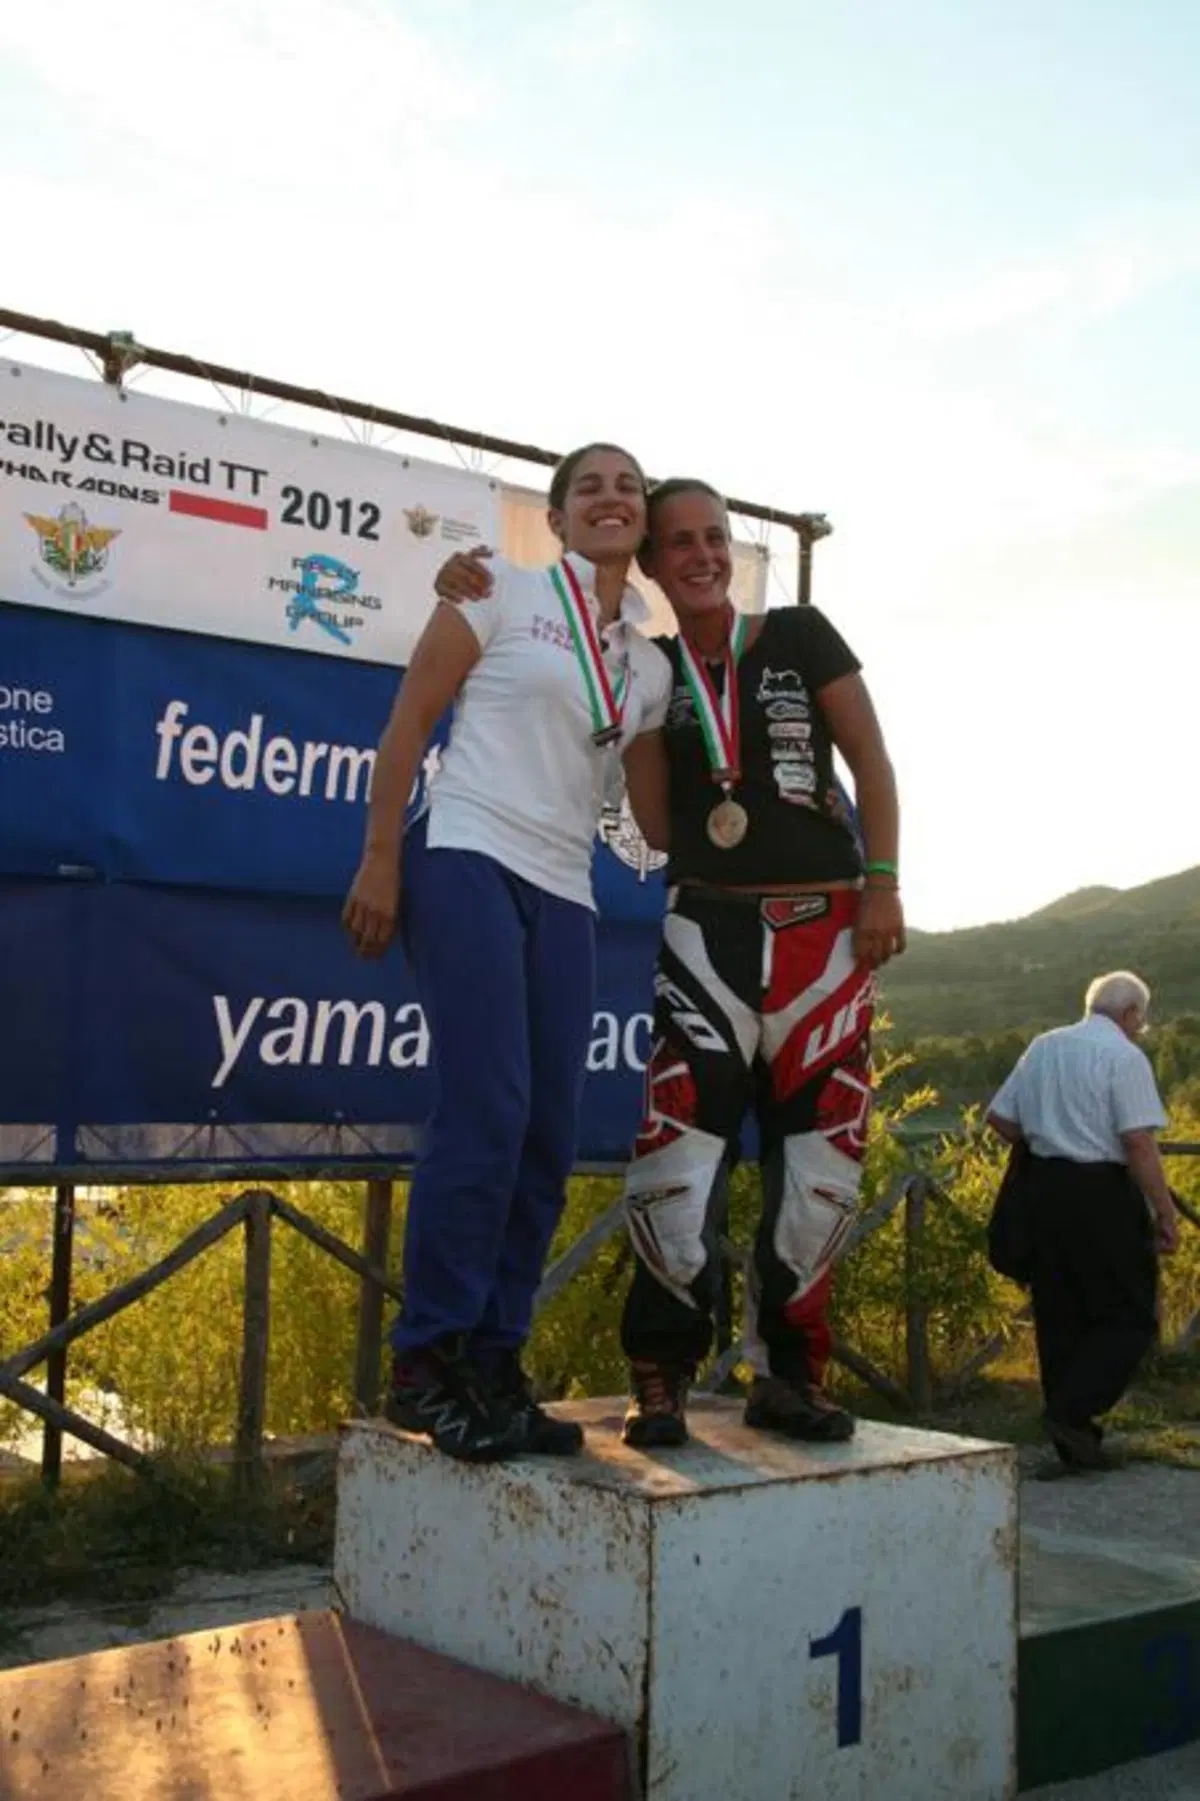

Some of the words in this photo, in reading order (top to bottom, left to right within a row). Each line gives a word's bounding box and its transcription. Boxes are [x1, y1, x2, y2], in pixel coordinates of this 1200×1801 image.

[219, 460, 268, 496] TT
[281, 486, 381, 541] 2012
[808, 1606, 862, 1748] 1
